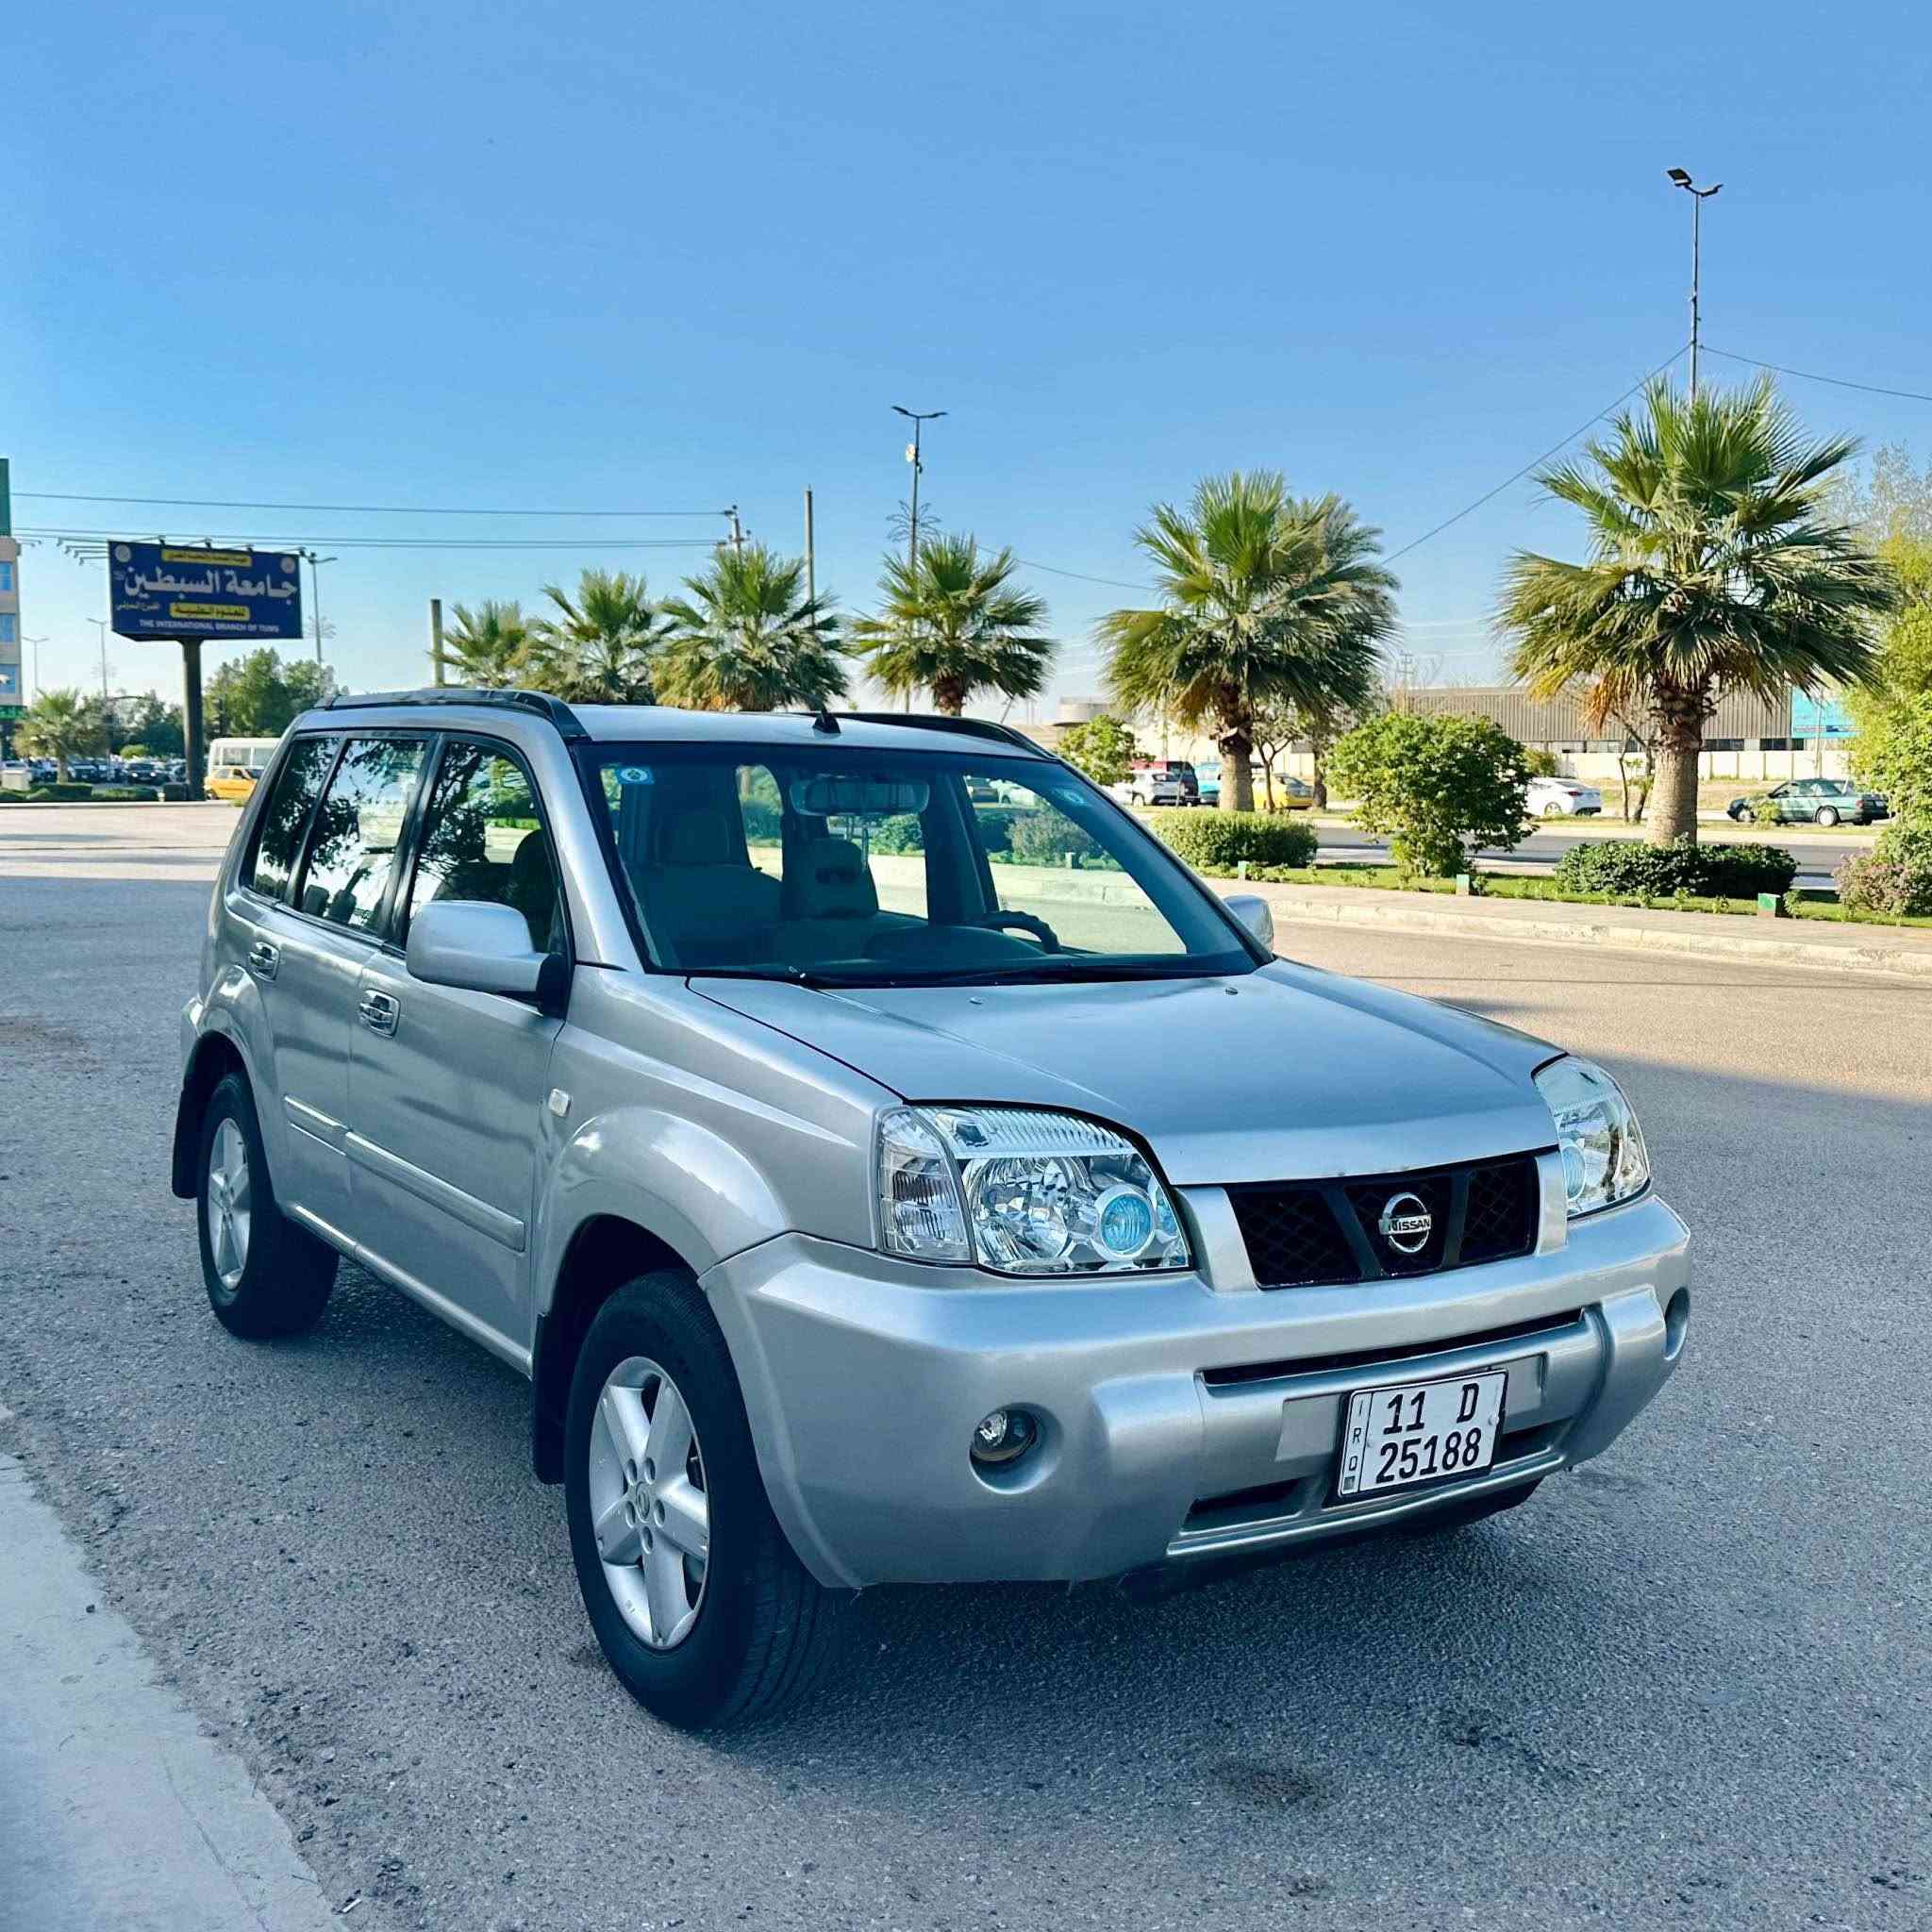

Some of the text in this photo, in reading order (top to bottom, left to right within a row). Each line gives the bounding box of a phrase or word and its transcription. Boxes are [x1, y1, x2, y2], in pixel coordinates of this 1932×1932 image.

[125, 566, 297, 606] جامعة السبطين
[1389, 1217, 1430, 1232] NISSAN
[1383, 1383, 1479, 1435] 11 D
[1375, 1427, 1482, 1484] 25188
